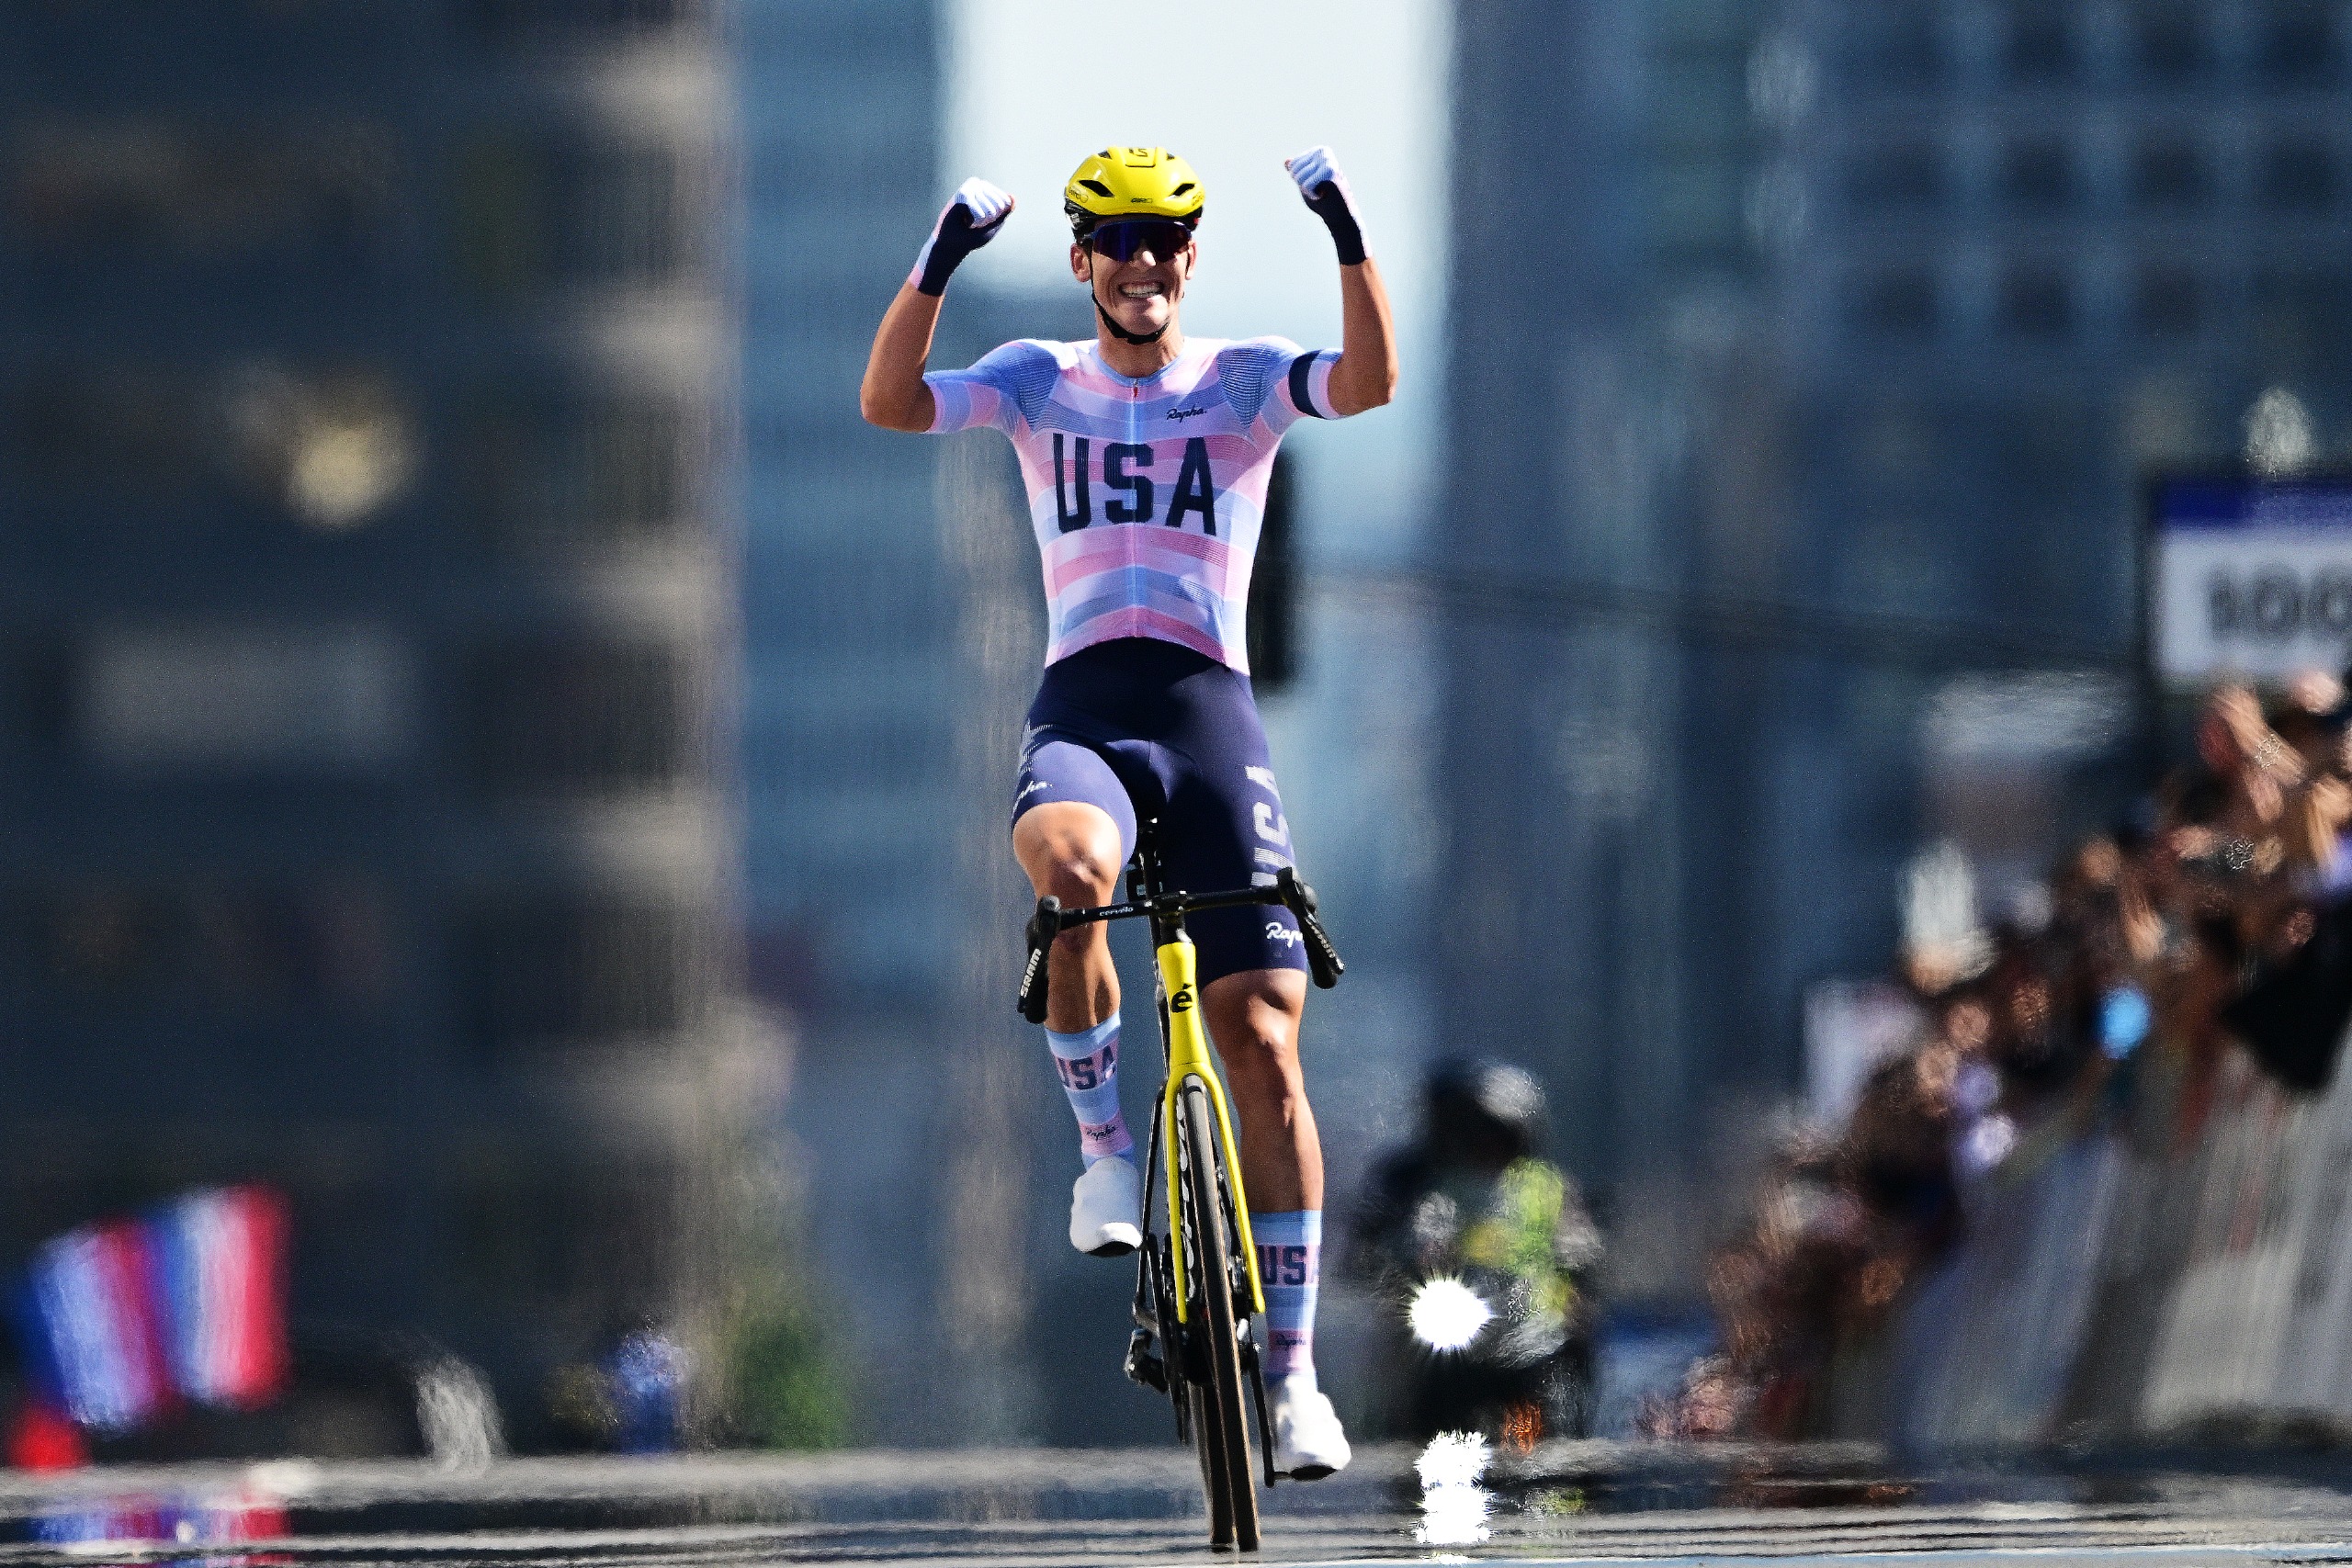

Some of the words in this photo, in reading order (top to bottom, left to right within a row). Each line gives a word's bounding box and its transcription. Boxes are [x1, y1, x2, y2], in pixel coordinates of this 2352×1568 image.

[1053, 433, 1216, 536] USA
[1265, 921, 1303, 948] Rap
[1020, 948, 1042, 998] SRAM
